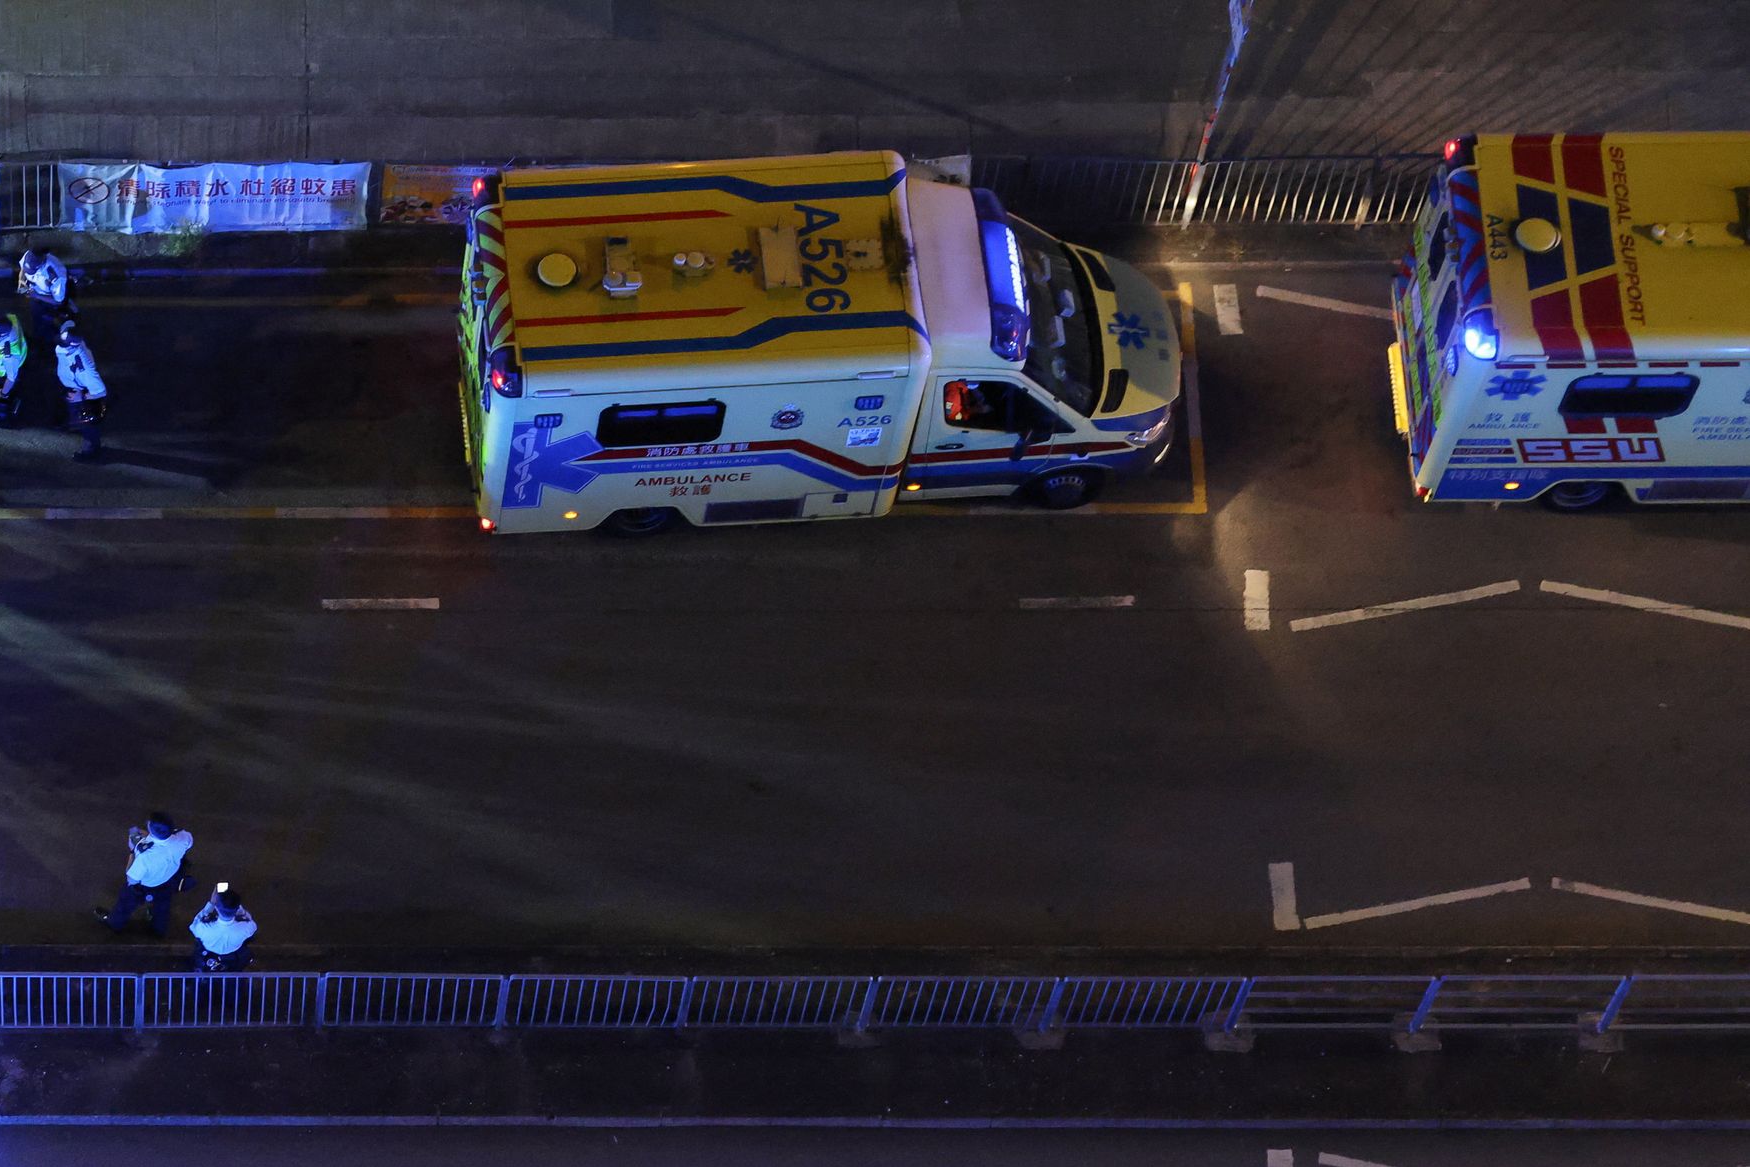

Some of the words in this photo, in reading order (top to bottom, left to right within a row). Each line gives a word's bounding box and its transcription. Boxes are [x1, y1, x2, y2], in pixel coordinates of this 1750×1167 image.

[116, 177, 230, 198] 清除積水
[240, 176, 357, 198] 杜絕蚊患
[1609, 145, 1632, 225] SPECIAL
[1486, 214, 1508, 261] A443
[794, 202, 852, 313] A526
[1619, 233, 1646, 327] SUPPORT
[837, 414, 892, 428] A526
[1520, 439, 1662, 462] SSU
[634, 472, 752, 487] AMBULANCE
